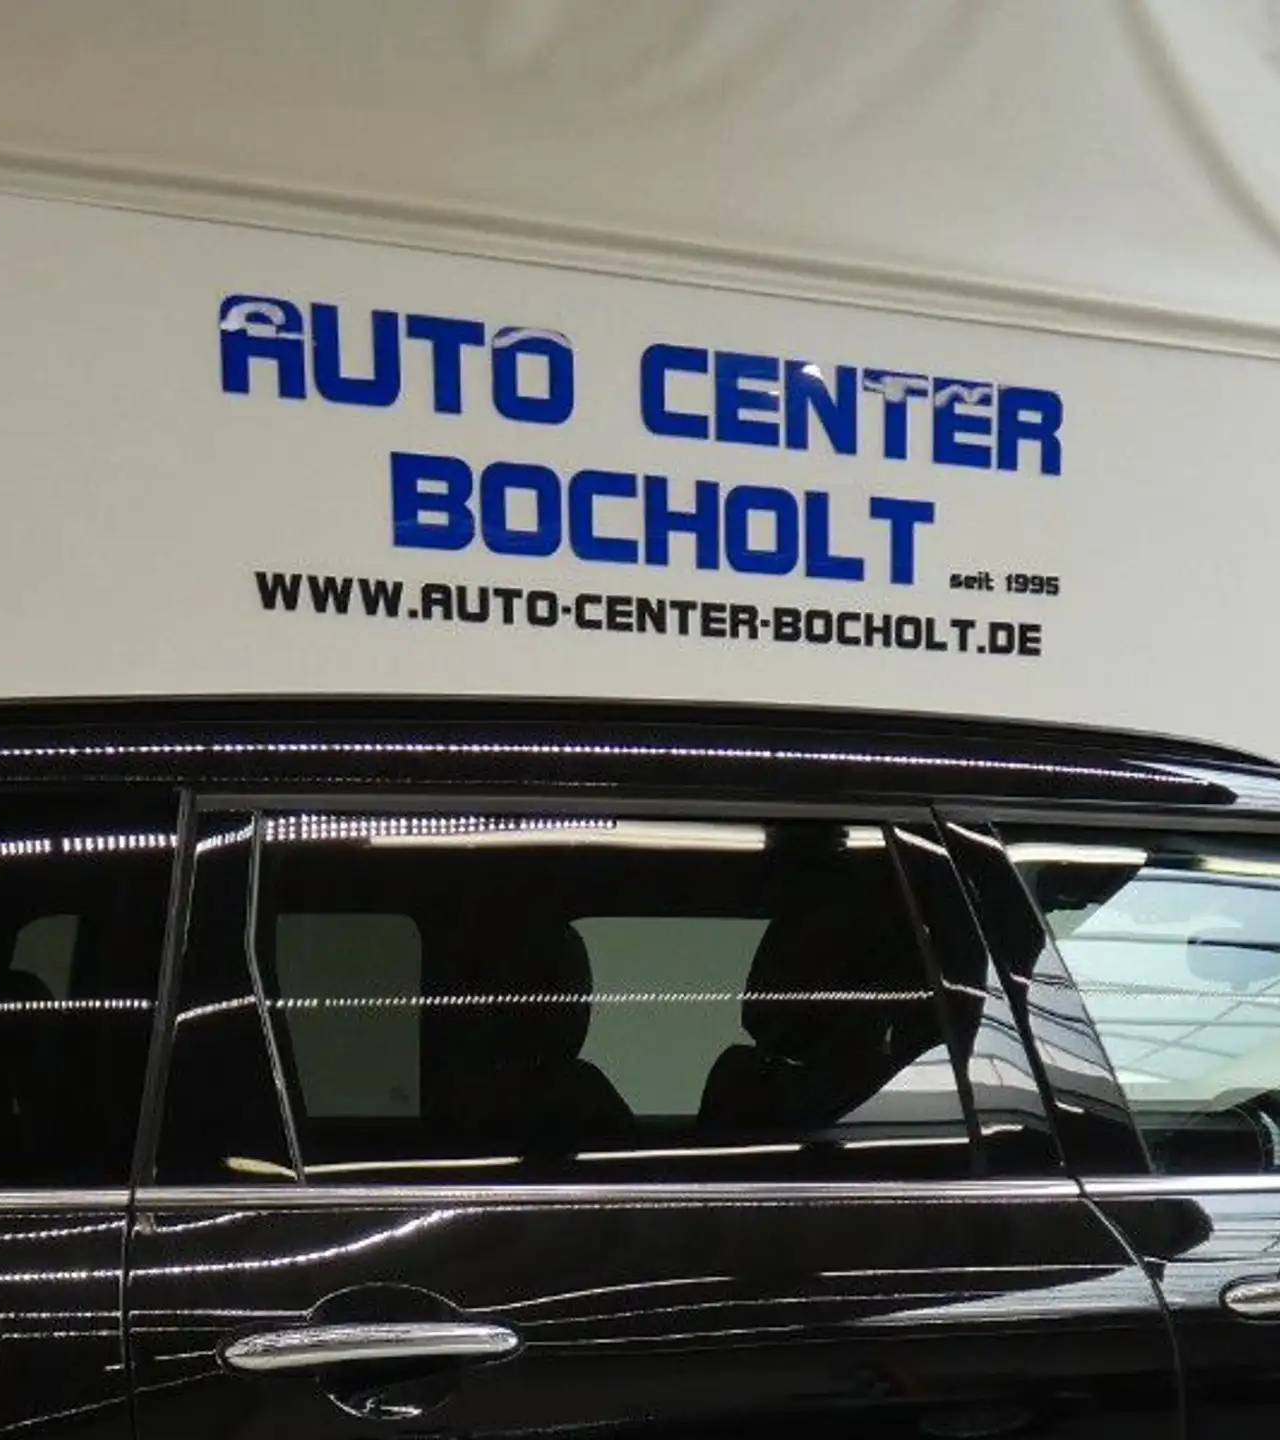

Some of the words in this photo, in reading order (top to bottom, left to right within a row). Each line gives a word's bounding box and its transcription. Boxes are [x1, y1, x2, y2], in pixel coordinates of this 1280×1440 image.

[220, 294, 574, 425] AUTO
[642, 342, 1063, 476] CENTER
[391, 451, 935, 586] BOCHOLT
[255, 571, 1042, 657] WWW.AUTO-CENTER-BOCHOLT.DE
[950, 571, 995, 592] seit
[1006, 573, 1060, 596] 1995
